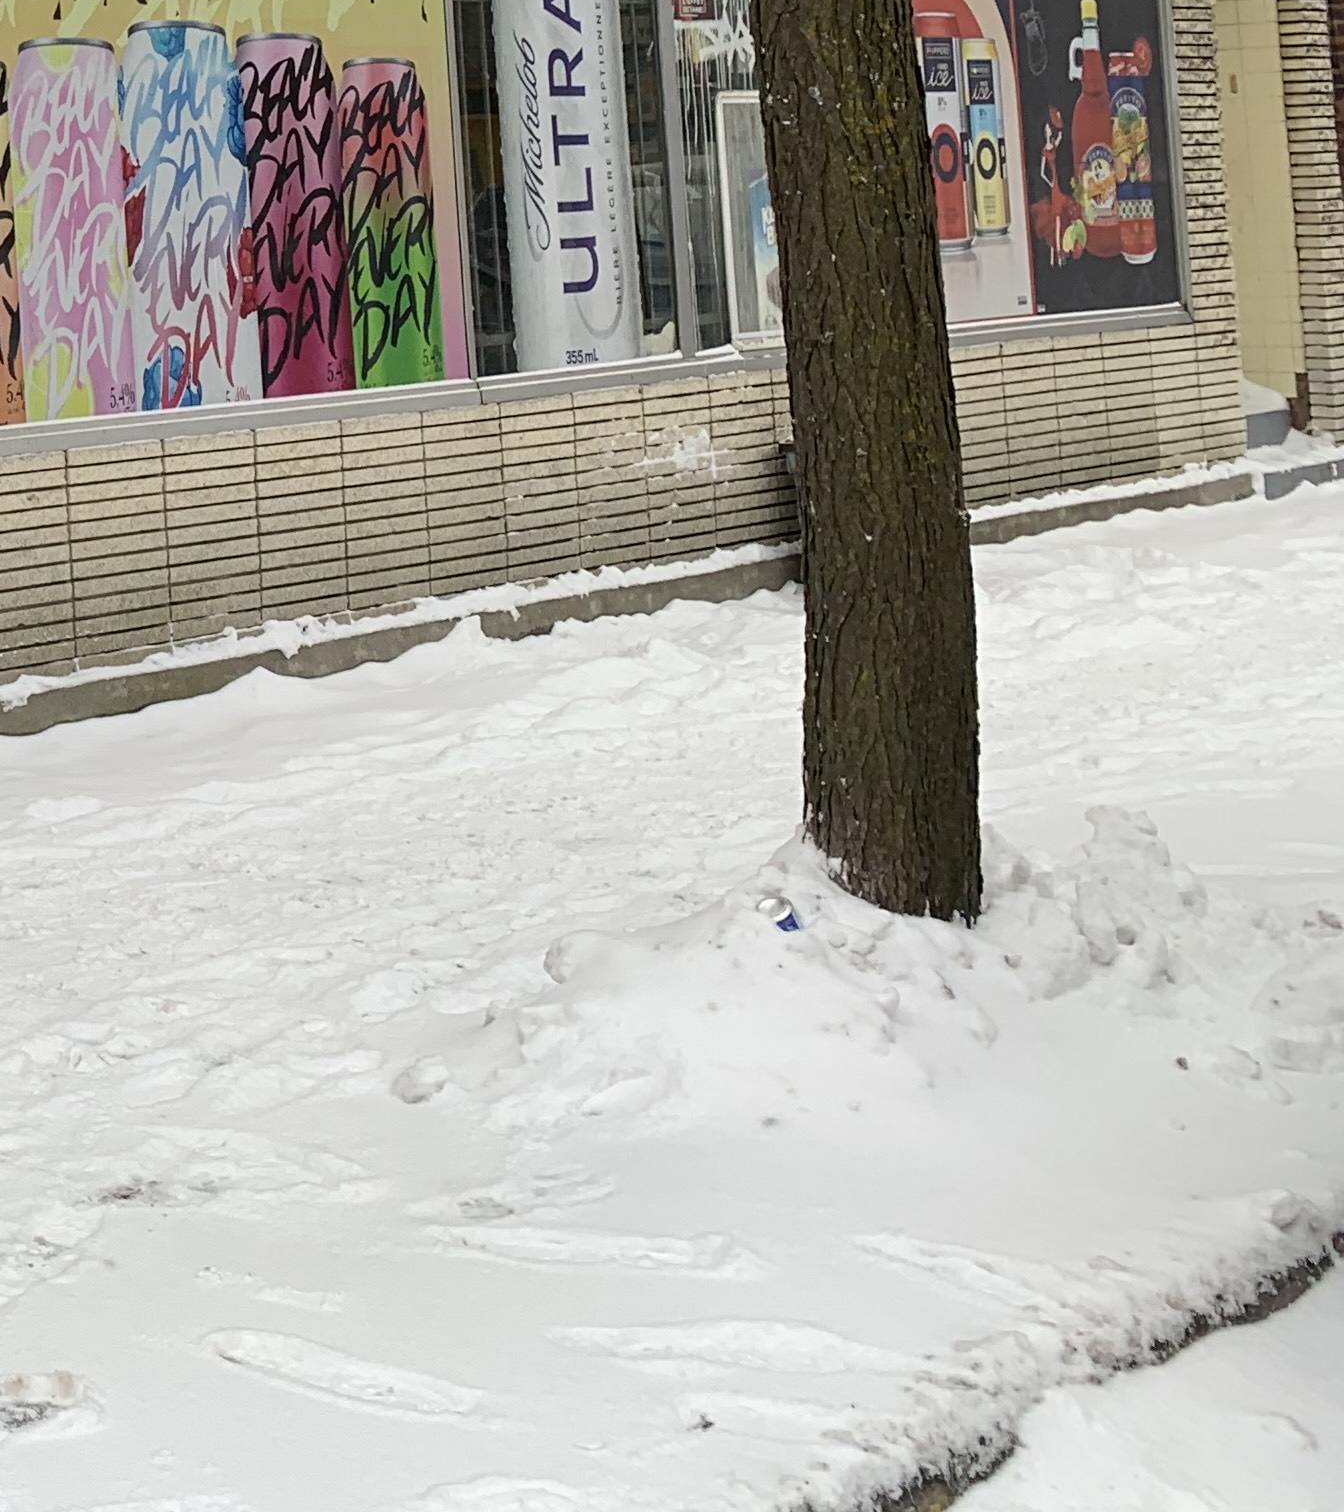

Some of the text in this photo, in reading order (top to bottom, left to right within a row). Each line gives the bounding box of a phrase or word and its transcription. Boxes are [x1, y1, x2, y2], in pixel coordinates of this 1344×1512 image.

[926, 66, 954, 87] ice
[972, 83, 993, 101] ice
[513, 30, 552, 251] Michelob
